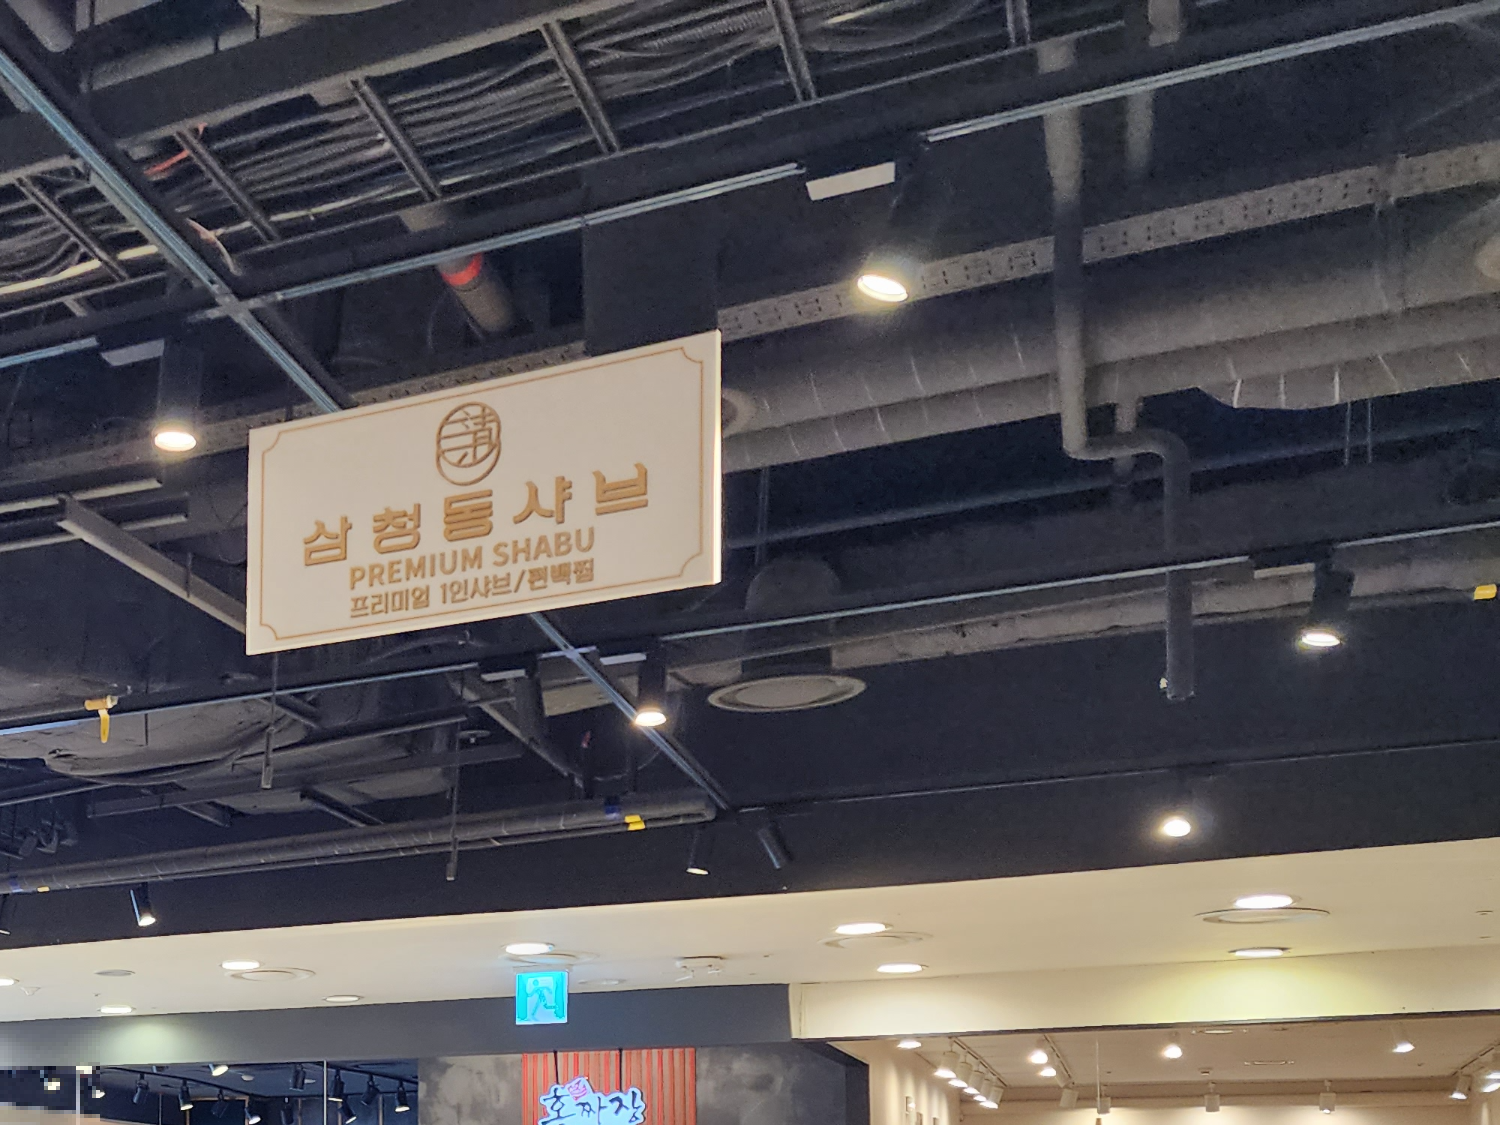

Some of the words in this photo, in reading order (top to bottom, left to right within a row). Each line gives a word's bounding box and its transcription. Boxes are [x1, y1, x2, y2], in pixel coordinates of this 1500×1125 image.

[303, 462, 649, 567] 삼청동샤브
[349, 547, 483, 589] PREMIUM
[493, 527, 595, 566] SHABU
[350, 584, 431, 618] 프리미엄
